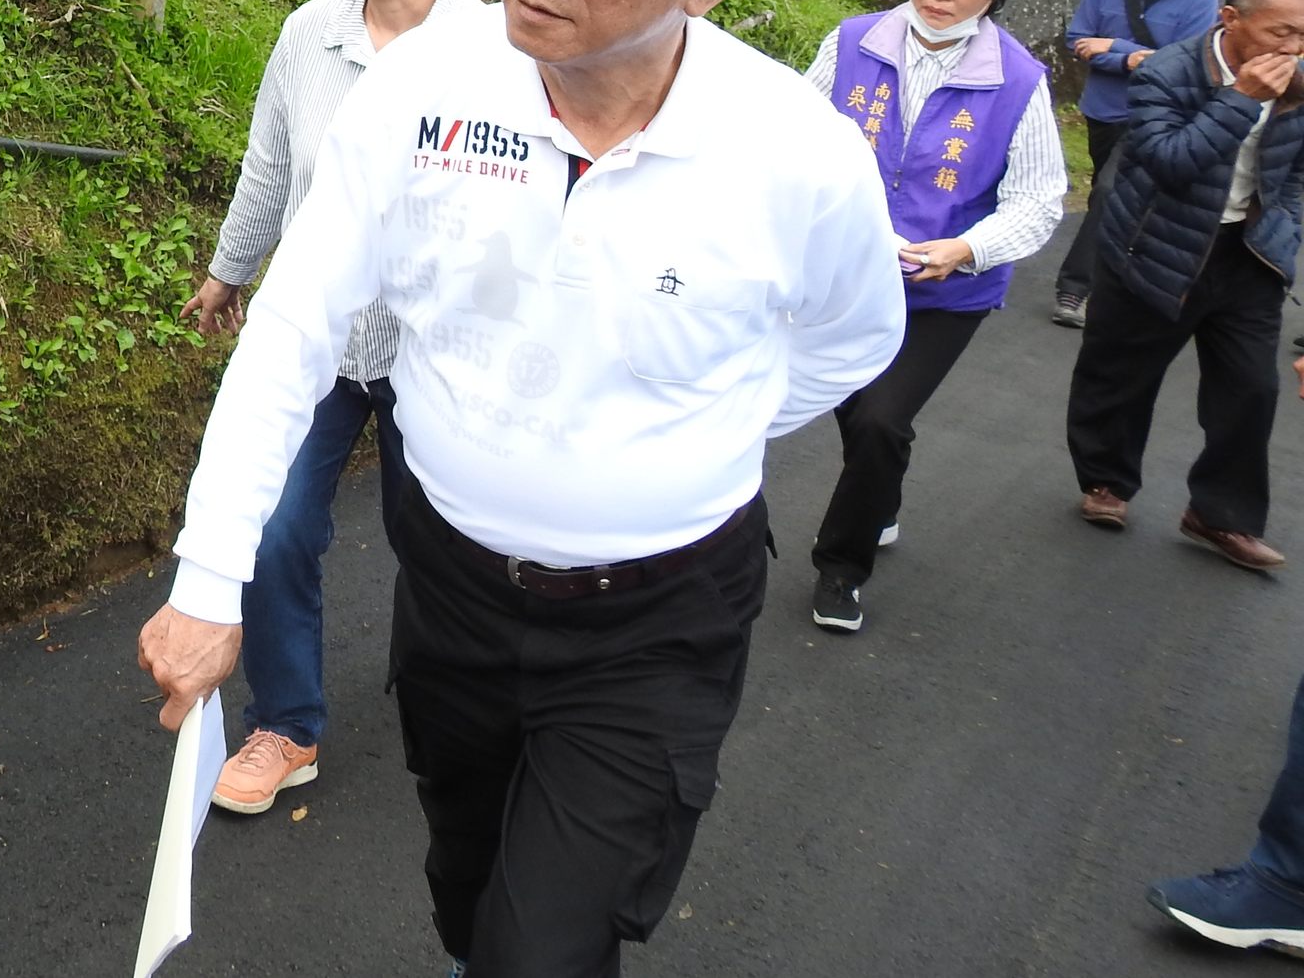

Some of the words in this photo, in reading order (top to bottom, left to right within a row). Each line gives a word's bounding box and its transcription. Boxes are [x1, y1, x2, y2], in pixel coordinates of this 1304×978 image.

[414, 155, 473, 174] 17-MILE
[479, 161, 529, 185] DRIVE
[933, 108, 975, 192] 無黨籍
